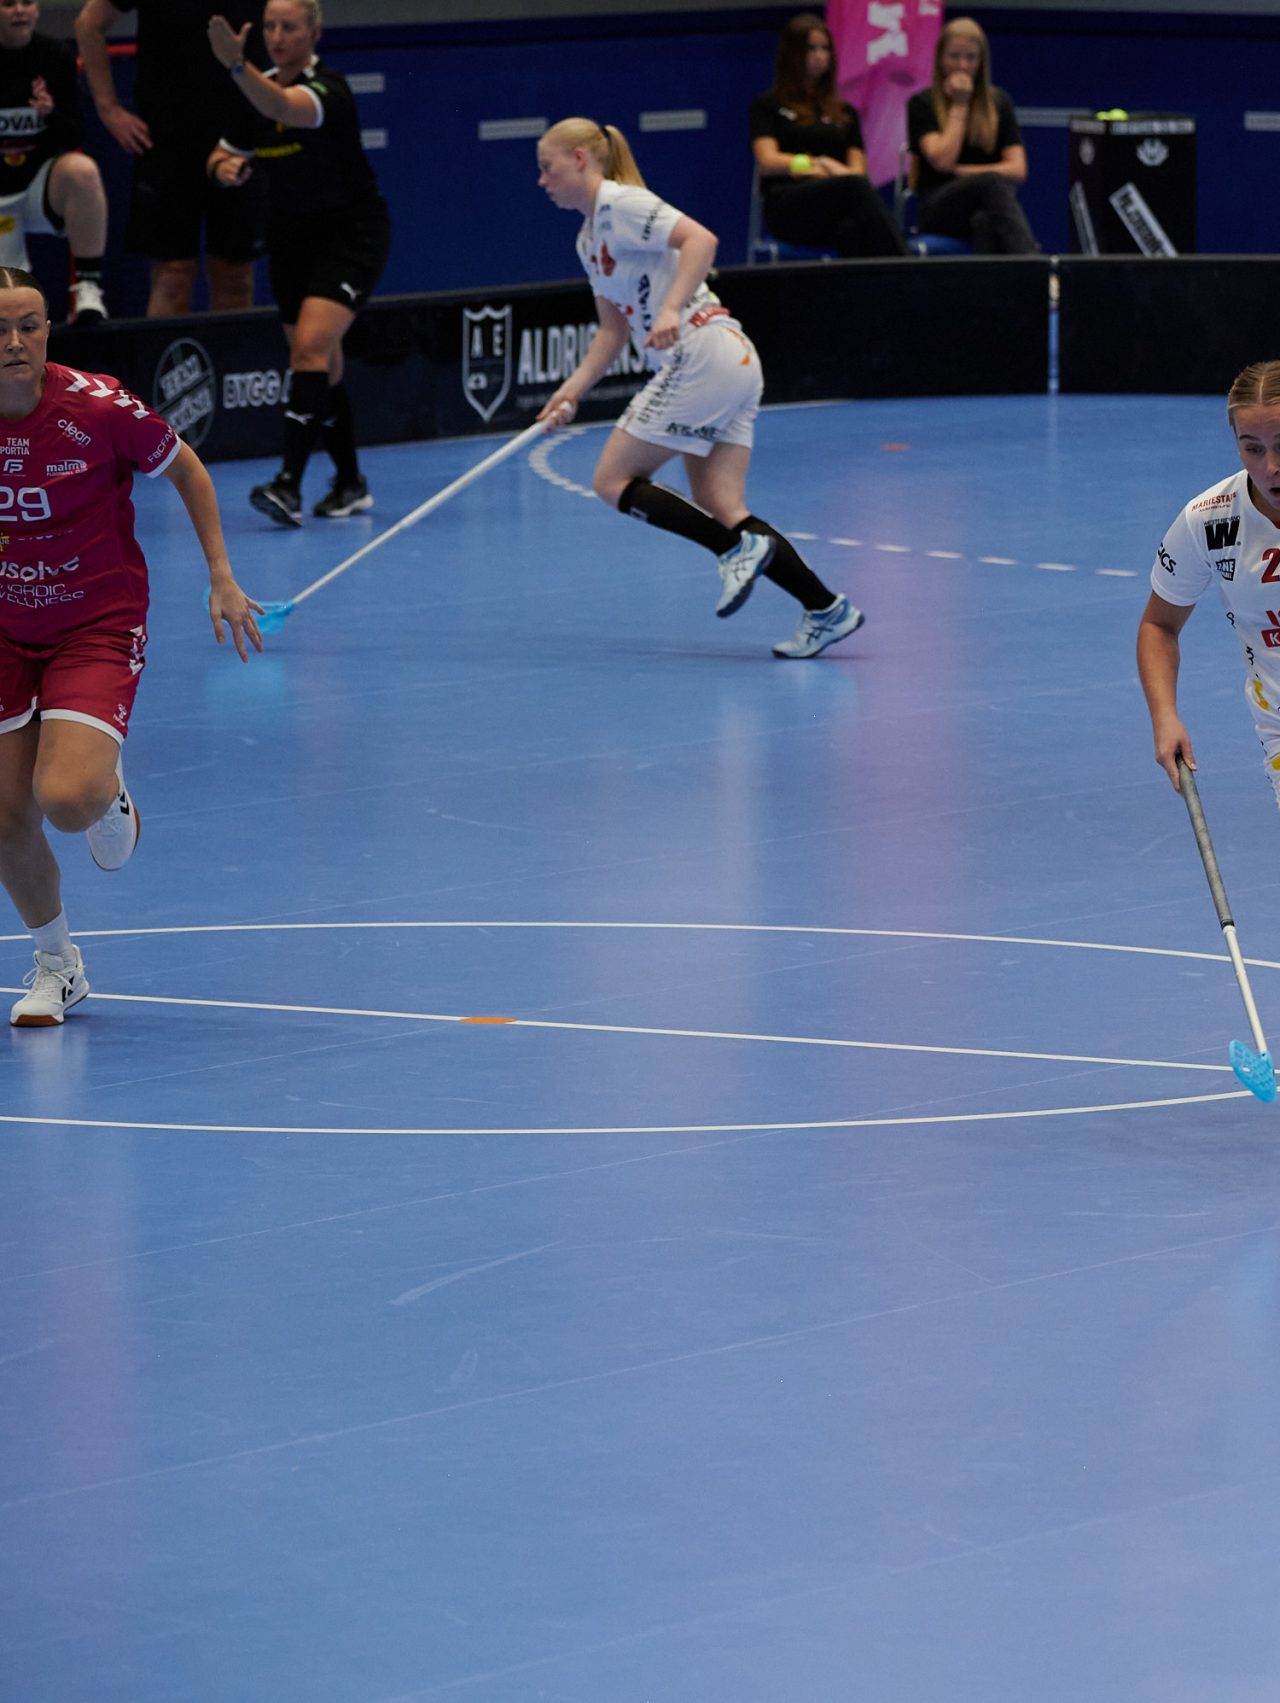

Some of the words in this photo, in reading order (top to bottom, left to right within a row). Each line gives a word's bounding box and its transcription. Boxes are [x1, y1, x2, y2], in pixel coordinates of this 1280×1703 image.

[223, 369, 281, 409] BYGG
[7, 437, 30, 447] TEAM
[57, 418, 92, 447] clean
